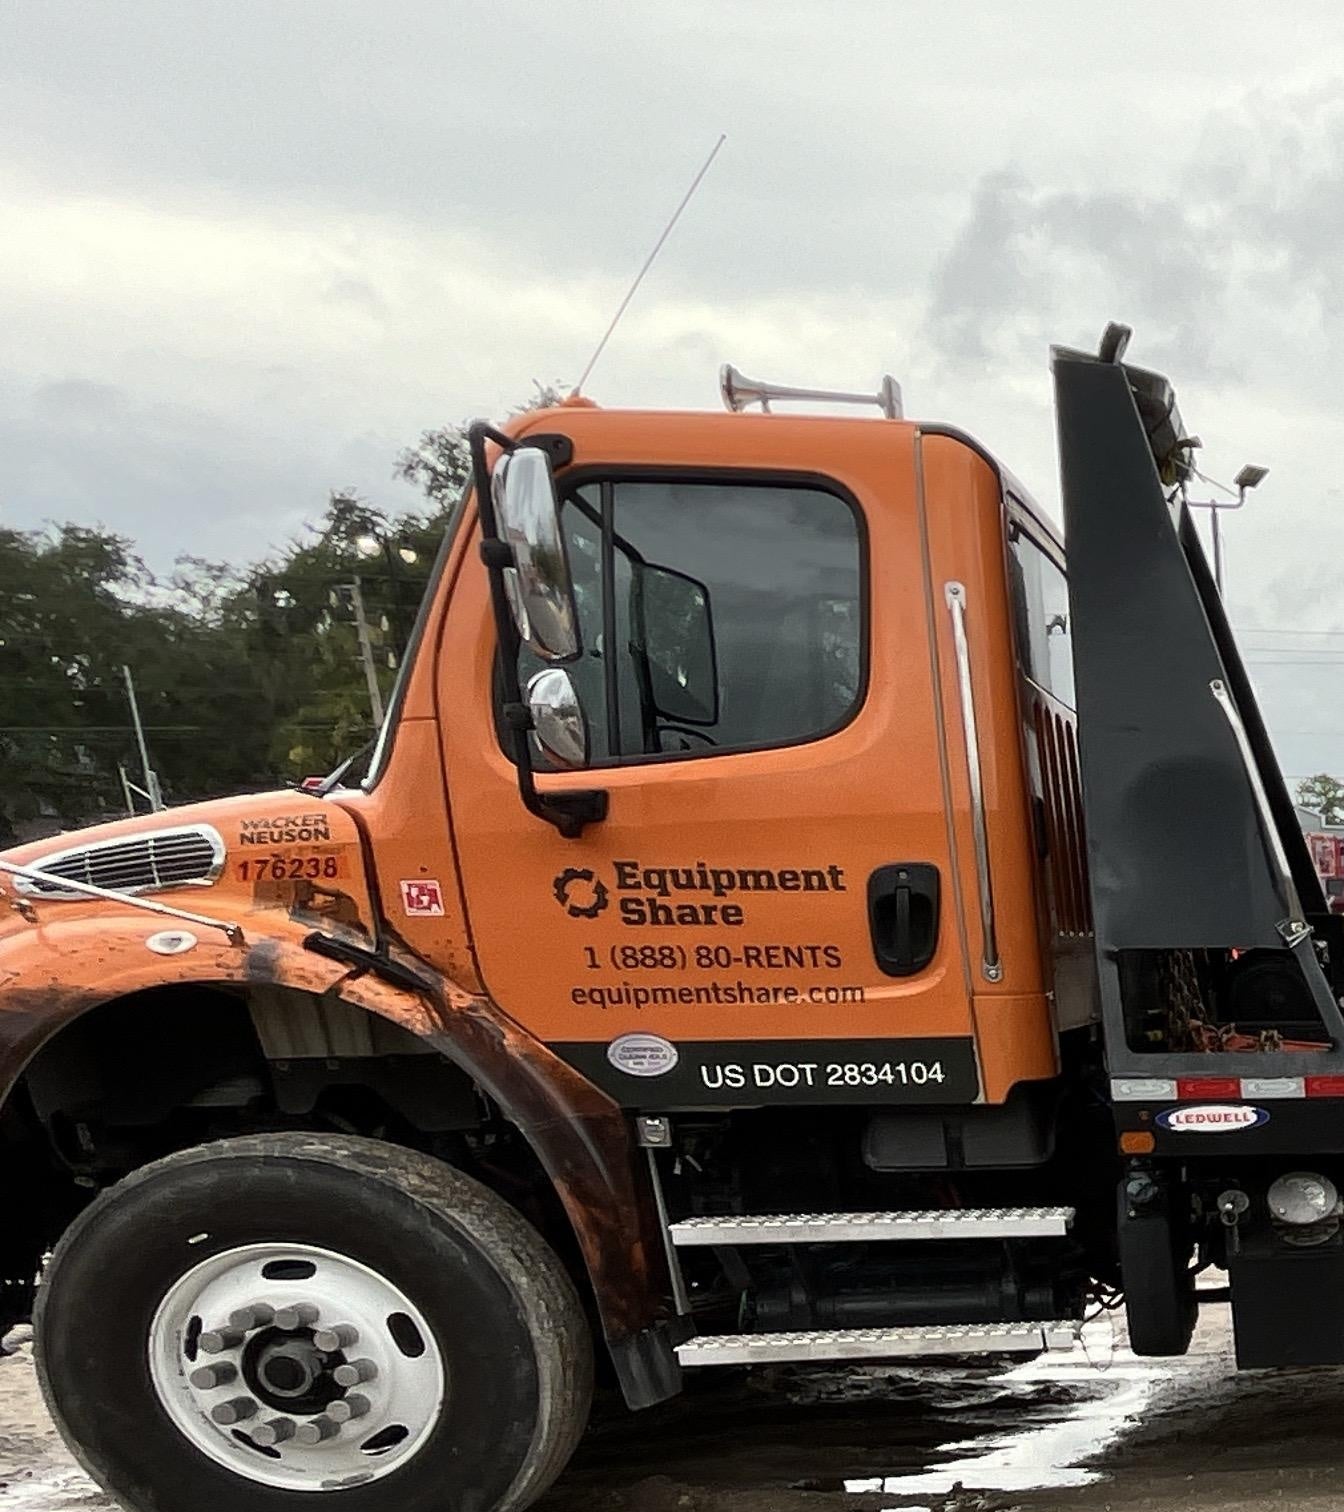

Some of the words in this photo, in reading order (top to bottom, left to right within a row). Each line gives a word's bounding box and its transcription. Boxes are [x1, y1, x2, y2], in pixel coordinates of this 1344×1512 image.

[240, 814, 327, 830] WACKER
[240, 828, 329, 845] NEUSON
[238, 856, 338, 880] 176238
[612, 861, 846, 897] Equipment
[620, 898, 744, 926] Share
[584, 947, 600, 969] 1
[610, 945, 687, 970] (888)
[696, 946, 842, 969] 80-RENTS
[571, 981, 866, 1010] equipmentshare.com
[700, 1064, 746, 1088] US
[754, 1063, 818, 1087] DOT
[827, 1062, 946, 1086] 2834104
[1175, 1112, 1251, 1124] LEDWELL
